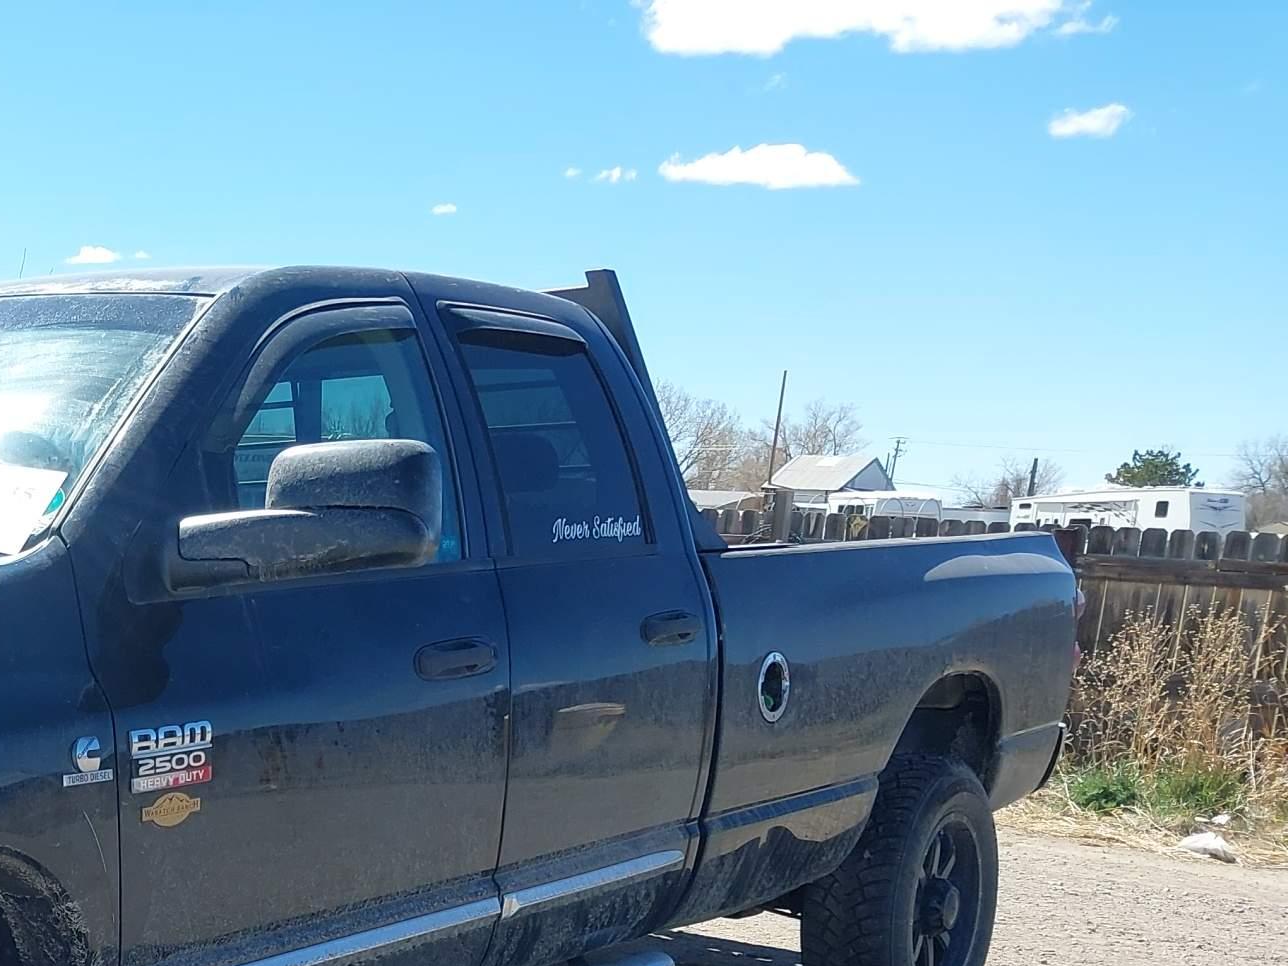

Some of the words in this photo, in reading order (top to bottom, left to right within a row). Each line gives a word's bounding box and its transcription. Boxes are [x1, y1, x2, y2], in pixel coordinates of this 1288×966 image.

[552, 517, 590, 543] Never
[592, 514, 642, 543] Satisfied
[129, 720, 213, 756] RAM
[138, 751, 206, 776] 2500
[67, 773, 89, 785] TURBO
[89, 771, 111, 782] DIESEL
[140, 776, 174, 790] HEAVY
[179, 769, 205, 784] DUTY
